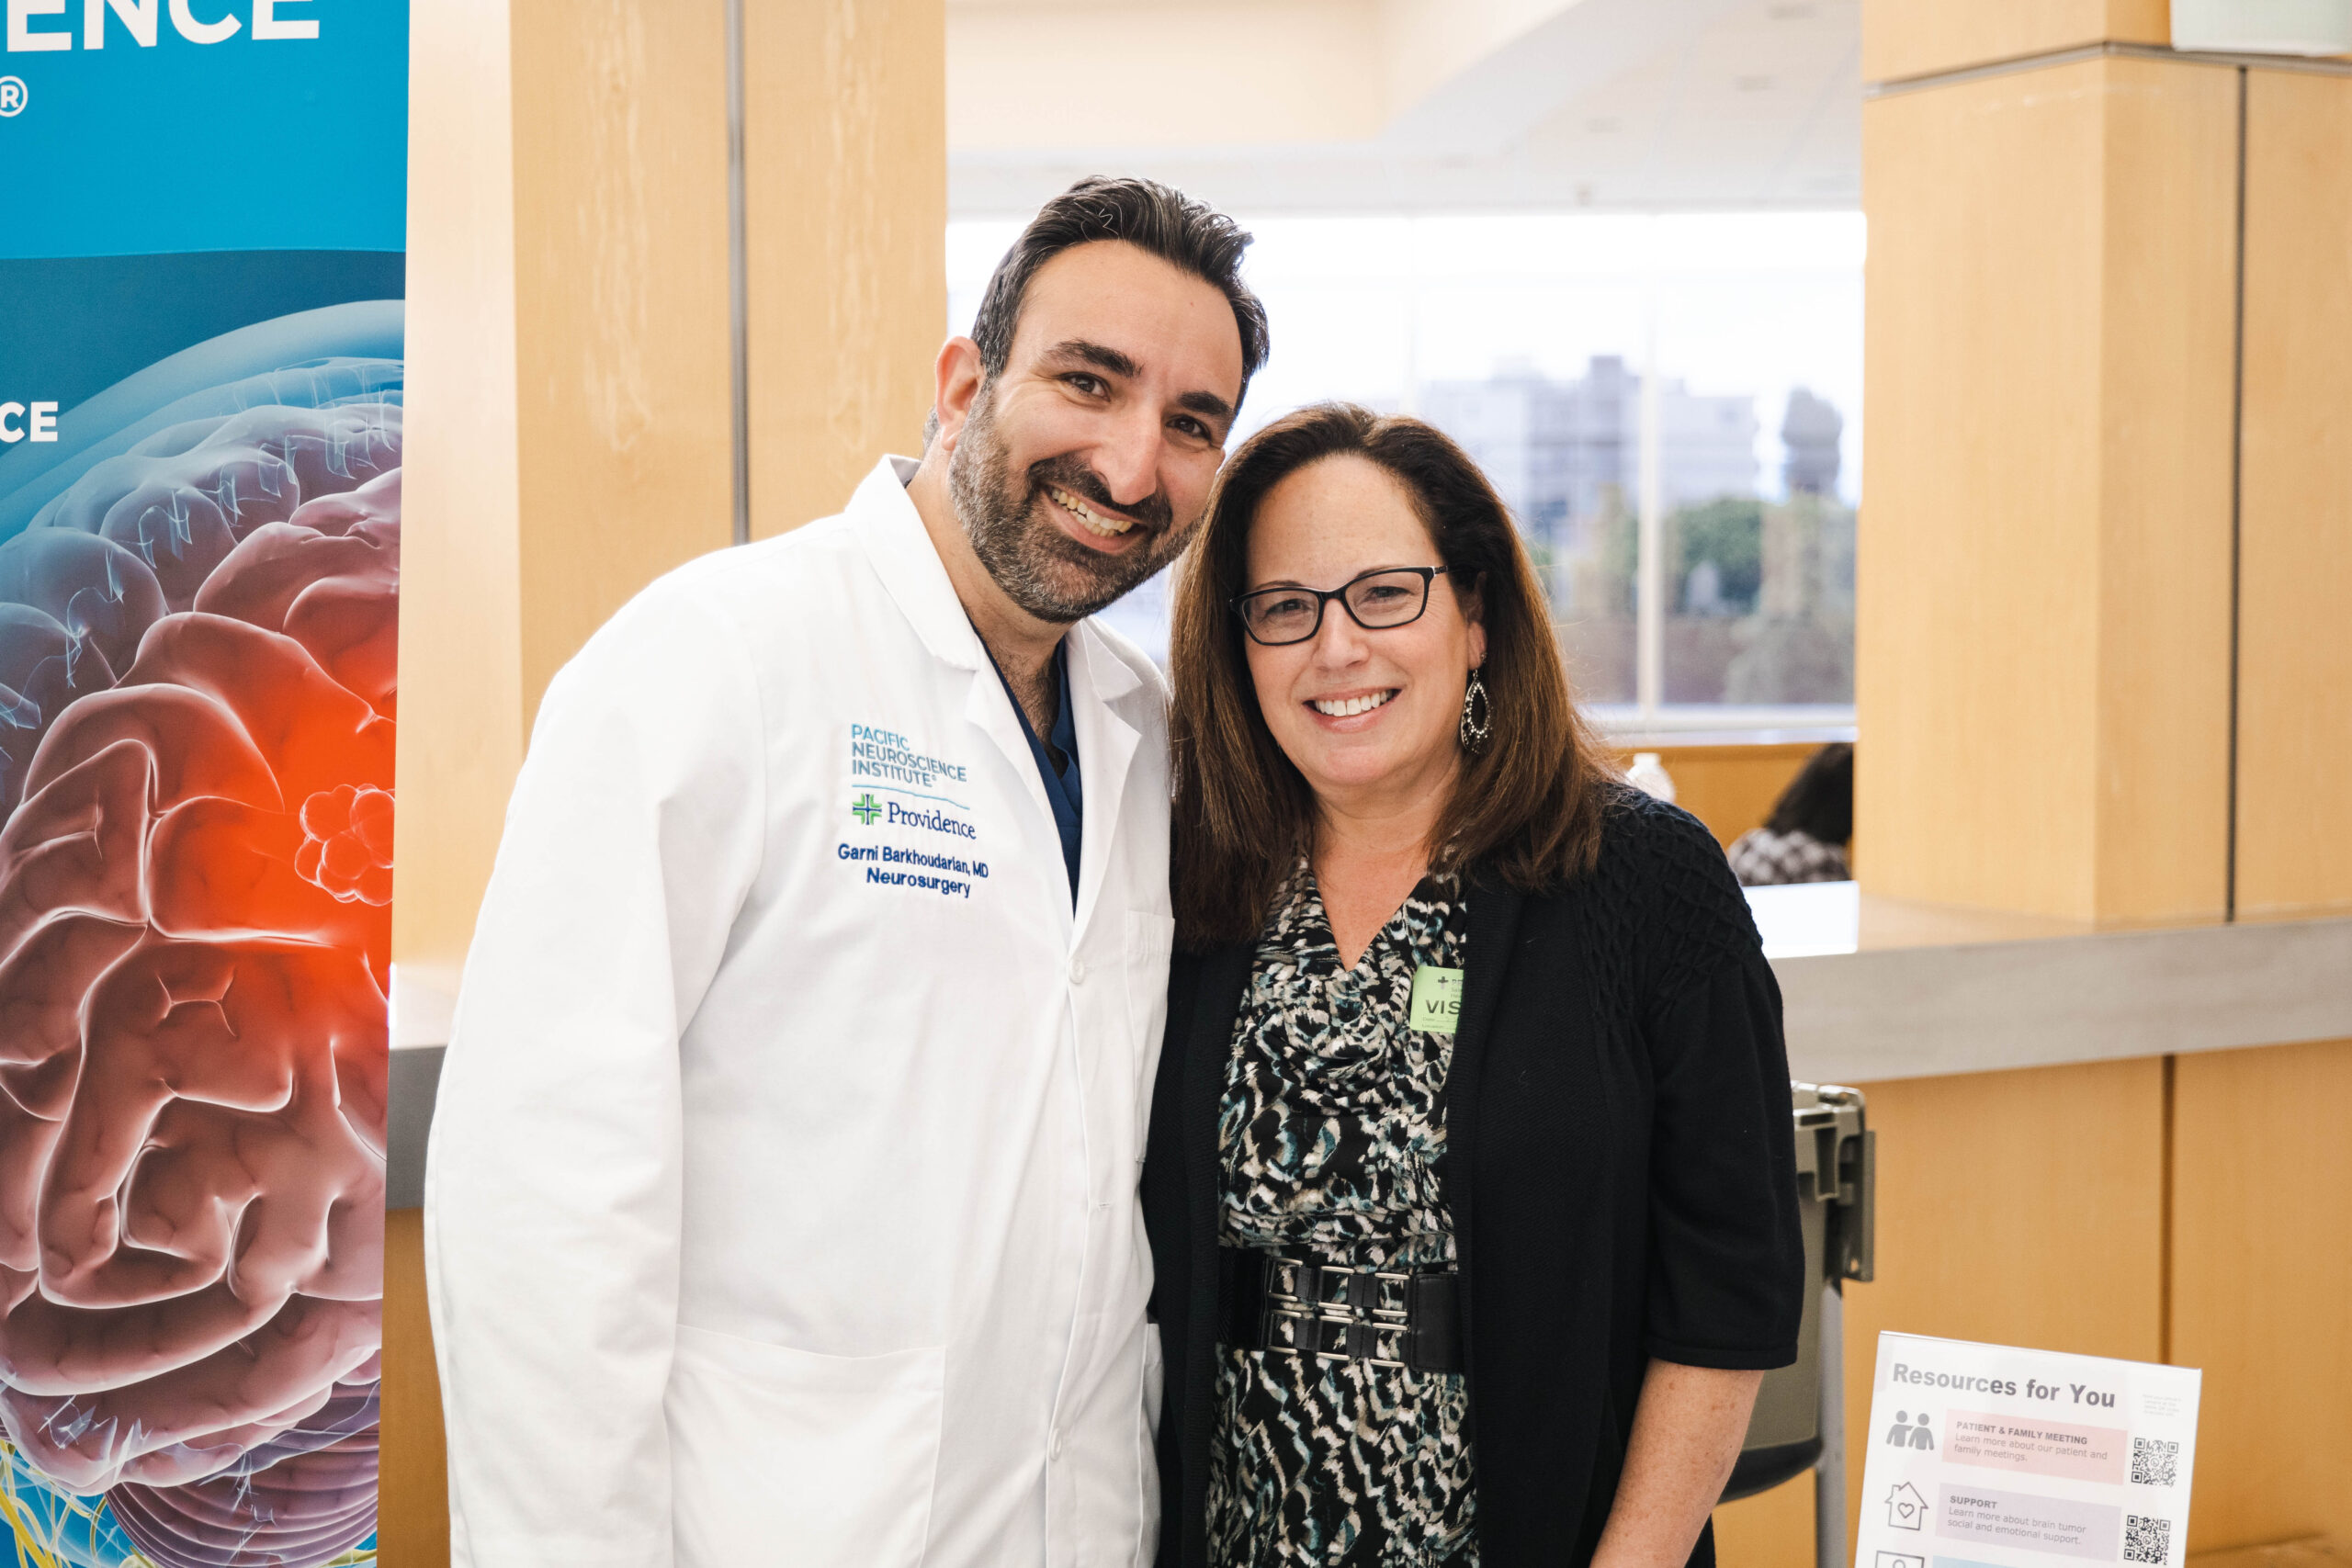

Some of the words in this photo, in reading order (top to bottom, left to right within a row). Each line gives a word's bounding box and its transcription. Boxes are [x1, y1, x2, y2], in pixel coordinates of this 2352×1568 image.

[851, 723, 910, 751] PACIFIC
[851, 741, 967, 782] NEUROSCIENCE
[888, 801, 977, 840] Providence
[838, 843, 879, 861] Garni
[882, 846, 971, 877] Barkhoudarian,
[972, 861, 989, 878] MD
[866, 867, 971, 898] Neurosurgery
[1893, 1363, 2018, 1396] Resources
[2026, 1379, 2061, 1401] for
[2069, 1383, 2116, 1408] You
[1955, 1433, 1980, 1444] Learn
[1983, 1438, 2007, 1448] more
[2008, 1439, 2035, 1450] about
[2037, 1444, 2053, 1452] our
[2055, 1446, 2087, 1458] patient
[2089, 1451, 2109, 1461] and
[1956, 1421, 1996, 1434] PATIENT
[1998, 1427, 2007, 1435] &
[2007, 1427, 2043, 1439] FAMILY
[2045, 1432, 2088, 1445] MEETING
[1954, 1444, 1982, 1457] family
[1950, 1495, 1997, 1509] SUPPORT
[1947, 1518, 1973, 1529] social
[1975, 1522, 1993, 1532] and
[1995, 1526, 2041, 1539] emotional
[1948, 1506, 1974, 1517] Learn
[1976, 1511, 2000, 1521] more
[2003, 1515, 2029, 1526] about
[2031, 1518, 2056, 1529] brain
[2058, 1522, 2086, 1534] tumor
